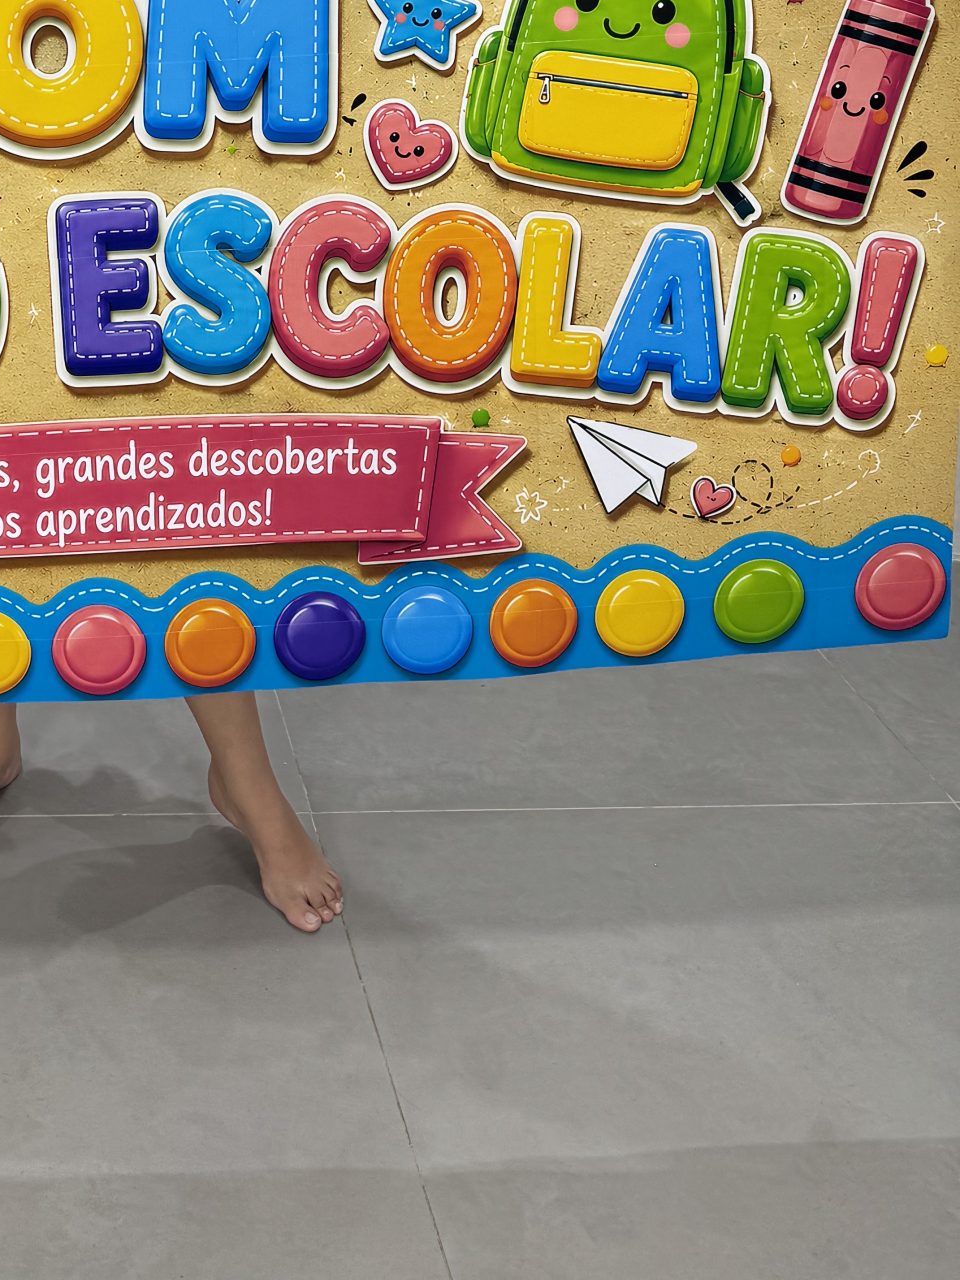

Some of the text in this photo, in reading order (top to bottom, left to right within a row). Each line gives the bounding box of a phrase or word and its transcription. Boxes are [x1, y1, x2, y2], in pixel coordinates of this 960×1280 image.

[54, 193, 920, 421] ESCOLAR!
[35, 439, 175, 499] grandes
[188, 435, 398, 478] descobertas
[35, 488, 273, 548] aprendizados!
